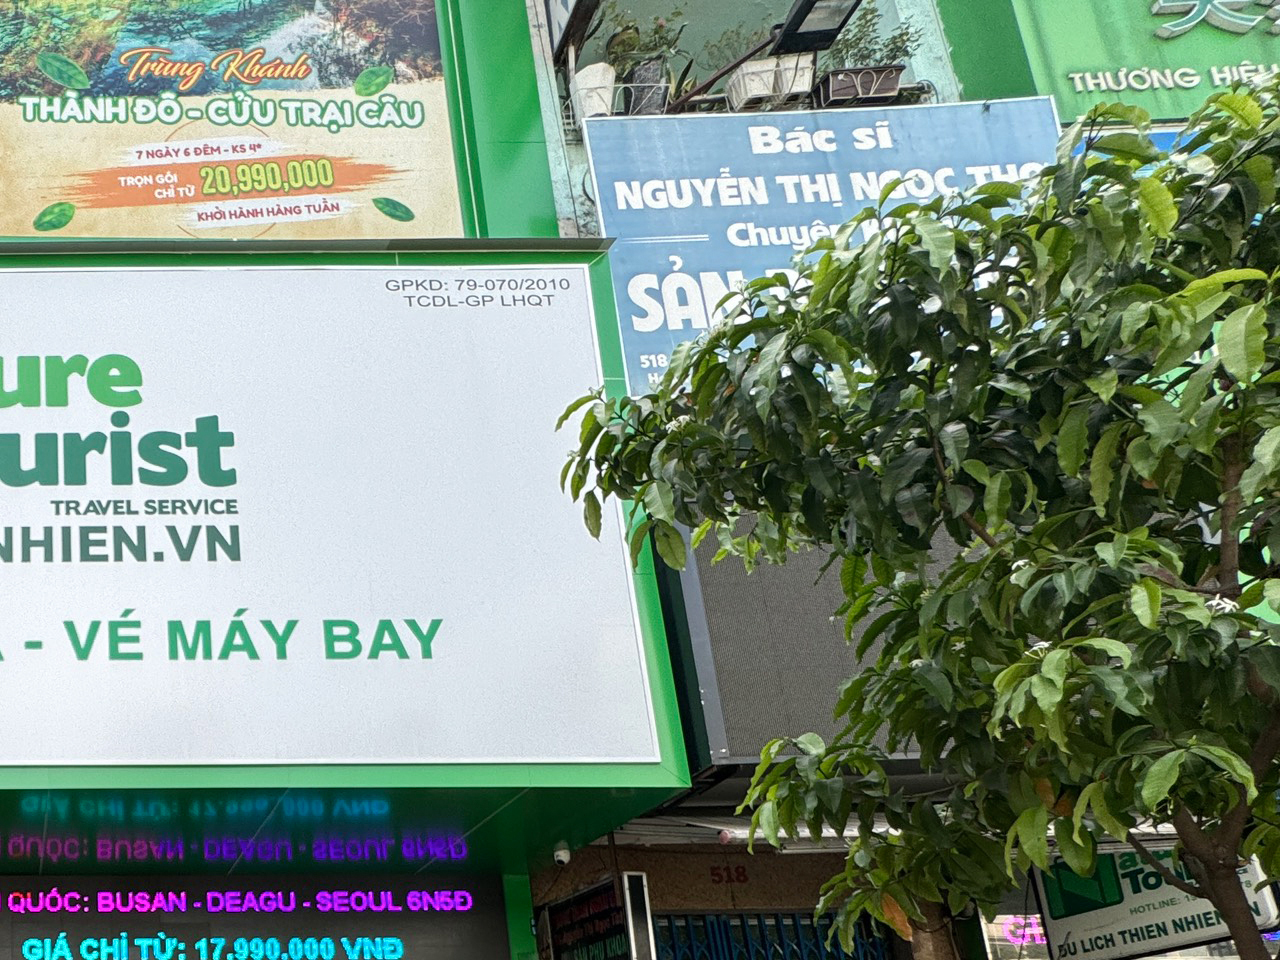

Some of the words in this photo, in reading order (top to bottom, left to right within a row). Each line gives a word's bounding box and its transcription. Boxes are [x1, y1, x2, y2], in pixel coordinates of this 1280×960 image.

[120, 46, 206, 91] Trùng
[211, 40, 314, 83] Khánh
[1068, 67, 1201, 92] THƯƠNG
[21, 90, 127, 124] THÀNH
[133, 89, 183, 124] ĐÔ
[205, 86, 276, 127] CỬU
[283, 100, 354, 134] TRẠI
[358, 94, 424, 128] CÂU
[748, 125, 836, 155] Bác
[853, 120, 893, 150] sĩ
[135, 150, 141, 160] 7
[145, 144, 180, 160] NGÀY
[183, 148, 190, 158] 6
[193, 142, 222, 157] ĐÊM
[232, 144, 248, 155] KS
[118, 176, 152, 190] TRỌN
[155, 173, 178, 185] GÓI
[200, 158, 335, 196] 20,990,000
[613, 167, 768, 211] NGUYỄN
[775, 173, 841, 207] THỊ
[851, 168, 959, 203] NGỌC
[197, 206, 226, 222] KHỞI
[228, 203, 263, 219] HÀNH
[266, 201, 301, 217] HÀNG
[385, 279, 449, 291] GPKD:
[454, 278, 570, 291] 79-070/2010
[404, 295, 494, 307] TCDL-GP
[501, 294, 555, 307] LHQT
[640, 353, 667, 368] 518
[51, 500, 138, 515] TRAVEL
[144, 499, 239, 514] SERVICE
[63, 609, 144, 661] VÉ
[168, 609, 300, 661] MÁY
[323, 619, 444, 661] BAY
[710, 865, 748, 884] 518
[6, 887, 90, 915] QUỐC:
[96, 891, 187, 913] BUSAN
[206, 891, 296, 913] DEAGU
[316, 891, 402, 912] SEOUL
[407, 890, 473, 912] 6N5Đ
[1129, 897, 1181, 916] HOTLINE:
[341, 936, 404, 960] VNĐ
[1081, 932, 1116, 953] LICH
[1118, 921, 1169, 945] THIEN
